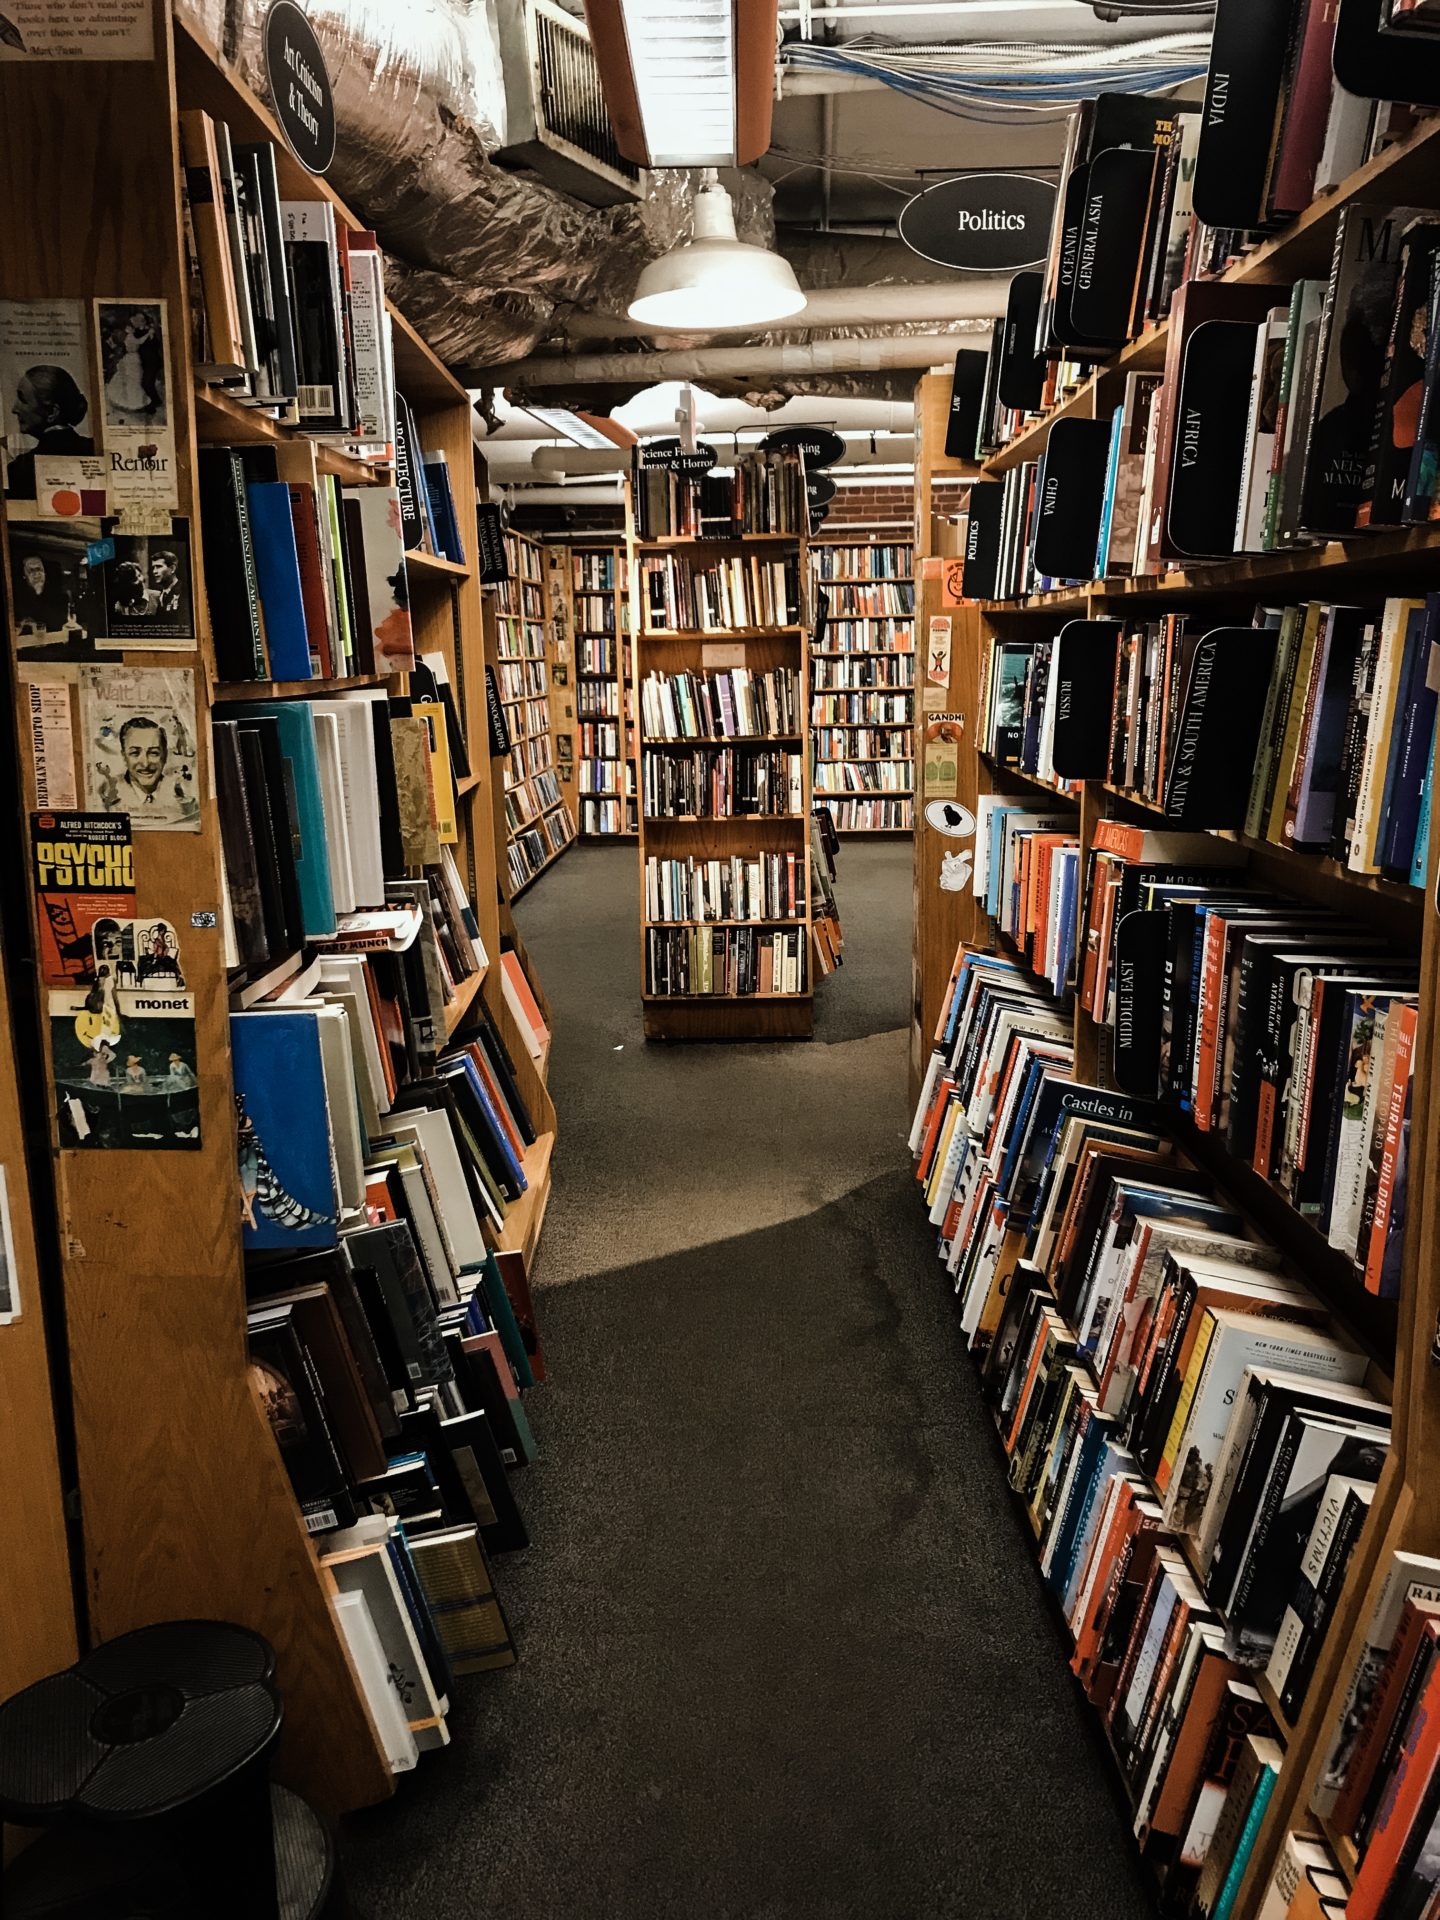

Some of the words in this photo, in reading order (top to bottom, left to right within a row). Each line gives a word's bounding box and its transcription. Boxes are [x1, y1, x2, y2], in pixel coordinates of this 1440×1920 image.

[284, 35, 295, 71] Art
[296, 51, 323, 107] Criticism
[289, 82, 296, 111] &
[297, 90, 319, 145] Theory
[1208, 72, 1230, 127] INDIA
[958, 208, 1026, 232] Politics
[1061, 226, 1078, 286] OCEANIA
[1078, 237, 1098, 290] GENERAL
[1090, 195, 1104, 234] ASIA
[1322, 223, 1345, 321] MANDELA
[952, 395, 961, 413] LAW
[640, 447, 672, 459] Science
[674, 446, 708, 457] Fion,
[1181, 408, 1202, 468] AFRICA
[110, 452, 168, 471] Renoir
[398, 420, 416, 521] ARCHITECTURE
[641, 460, 670, 470] antasy
[671, 460, 680, 469] &
[683, 459, 714, 469] Horror
[1043, 477, 1059, 516] CHINA
[478, 515, 492, 572] MONOGRAPHS
[487, 514, 503, 572] PHOTOGRAPHY
[967, 520, 980, 561] POLITICS
[96, 684, 131, 701] Walt
[1191, 641, 1218, 710] AMERICA
[29, 683, 41, 713] SHOP
[1059, 680, 1072, 721] RUSSIA
[1373, 684, 1383, 720] BACARDI
[31, 715, 44, 753] PHOTO
[487, 687, 506, 750] MONOGRAPHS
[928, 713, 965, 722] GANDHI
[1180, 714, 1201, 763] SOUTH
[1366, 741, 1375, 764] LONG
[34, 755, 48, 807] DEDMAN'S
[1176, 765, 1192, 777] &
[1362, 767, 1371, 790] FIGHT
[1168, 779, 1188, 818] LATIN
[1359, 793, 1367, 809] FOR
[60, 821, 82, 829] ALFRED
[83, 821, 122, 830] HITCHCOCK'S
[1037, 820, 1057, 829] THE
[1103, 825, 1130, 853] AMERICAS
[1356, 810, 1364, 833] CUBA
[37, 841, 135, 887] PSYCHO
[349, 937, 388, 949] MUNCH
[1120, 959, 1134, 993] EAST
[1276, 975, 1285, 1010] GUESTS
[135, 998, 189, 1010] monet
[1119, 996, 1133, 1049] MIDDLE
[1265, 982, 1279, 1034] AYATOLLAH
[1275, 1013, 1281, 1022] OF
[1368, 1055, 1377, 1076] THE
[1382, 1048, 1396, 1087] SNOW
[1061, 1094, 1115, 1118] Castles
[1119, 1107, 1134, 1121] in
[1358, 1083, 1374, 1148] MERCHANT
[1372, 1092, 1389, 1149] LEOPARD
[1386, 1082, 1406, 1145] TEHRAN
[1356, 1152, 1364, 1167] OF
[1351, 1172, 1362, 1206] SYRIA
[1373, 1151, 1395, 1228] CHILDREN
[1361, 1194, 1376, 1226] ALEX
[1255, 1341, 1268, 1349] NEW
[1269, 1343, 1284, 1351] YORK
[1285, 1346, 1302, 1355] TIMES
[1303, 1349, 1337, 1363] BESTSELLER
[1276, 1445, 1293, 1482] GUEST
[1264, 1482, 1282, 1522] HOUSE
[1256, 1521, 1270, 1546] FOR
[1306, 1497, 1340, 1574] VICTIMS
[1104, 1531, 1133, 1605] DEFEAT
